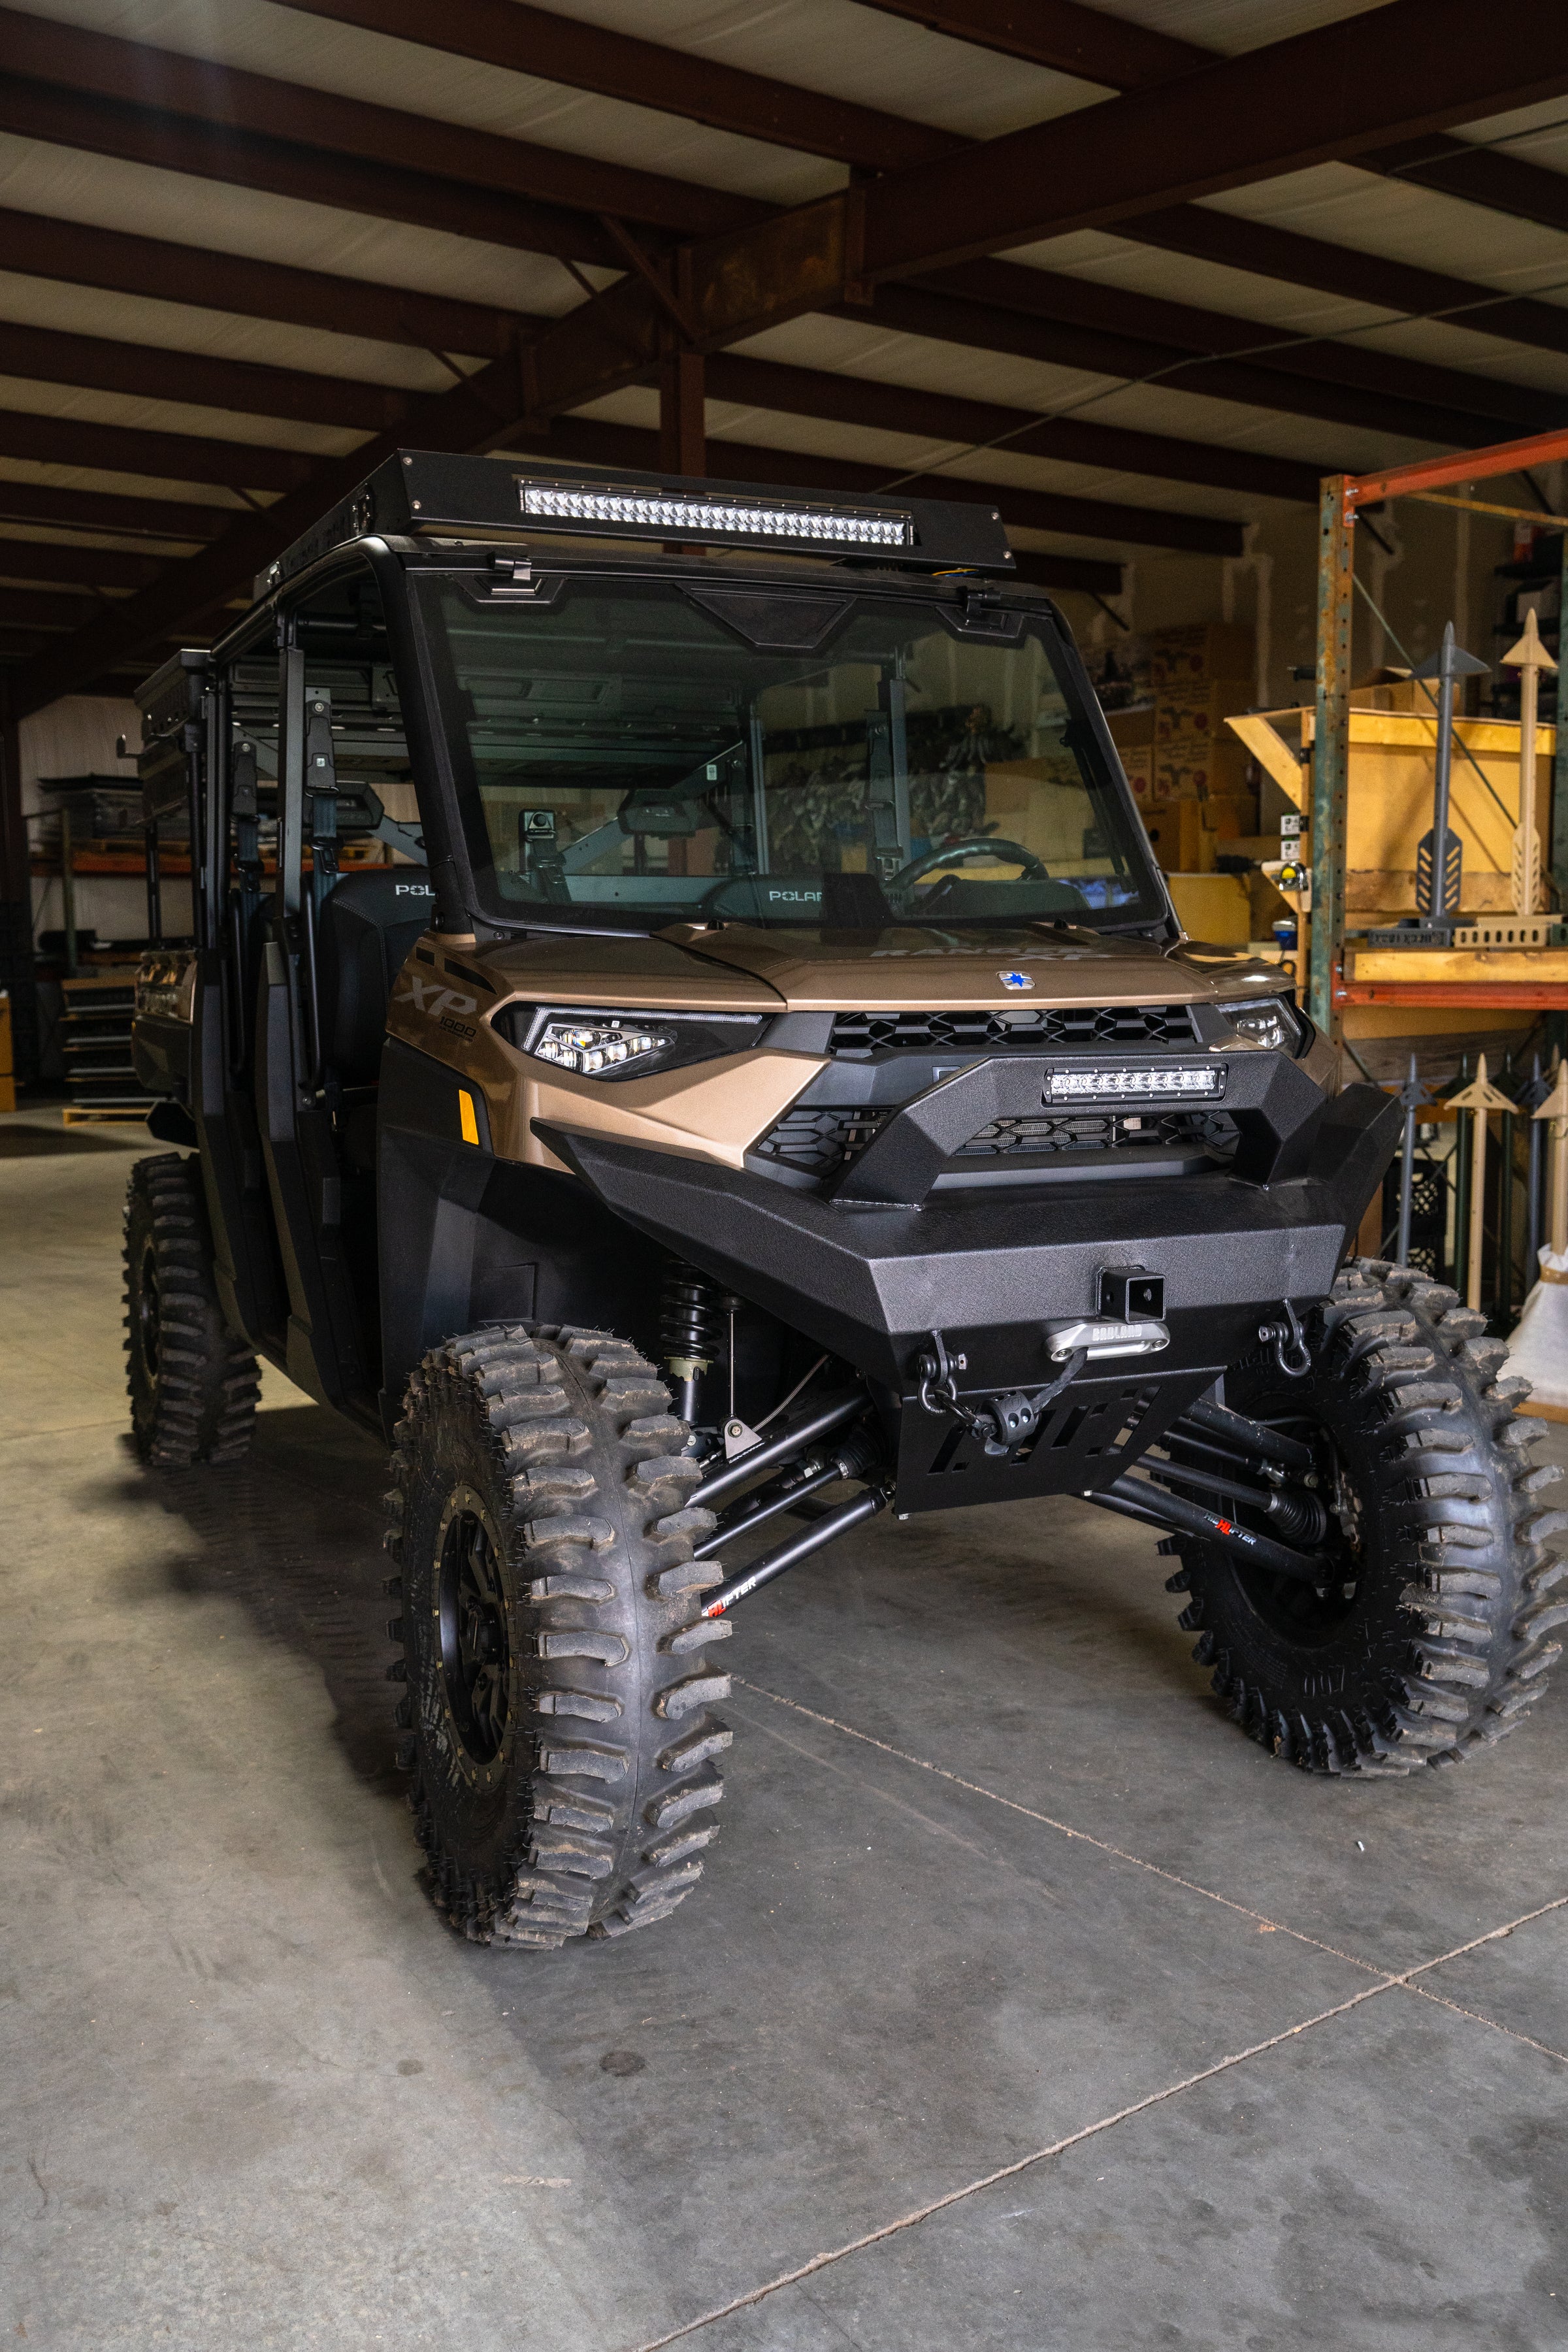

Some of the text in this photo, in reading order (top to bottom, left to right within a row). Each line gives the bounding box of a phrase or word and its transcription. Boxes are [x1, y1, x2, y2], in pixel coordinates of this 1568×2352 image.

[395, 885, 436, 896] POL
[870, 948, 1096, 957] RANGER
[394, 975, 478, 1017] XP
[440, 1016, 477, 1037] 1000
[1092, 1324, 1143, 1341] BADLAND
